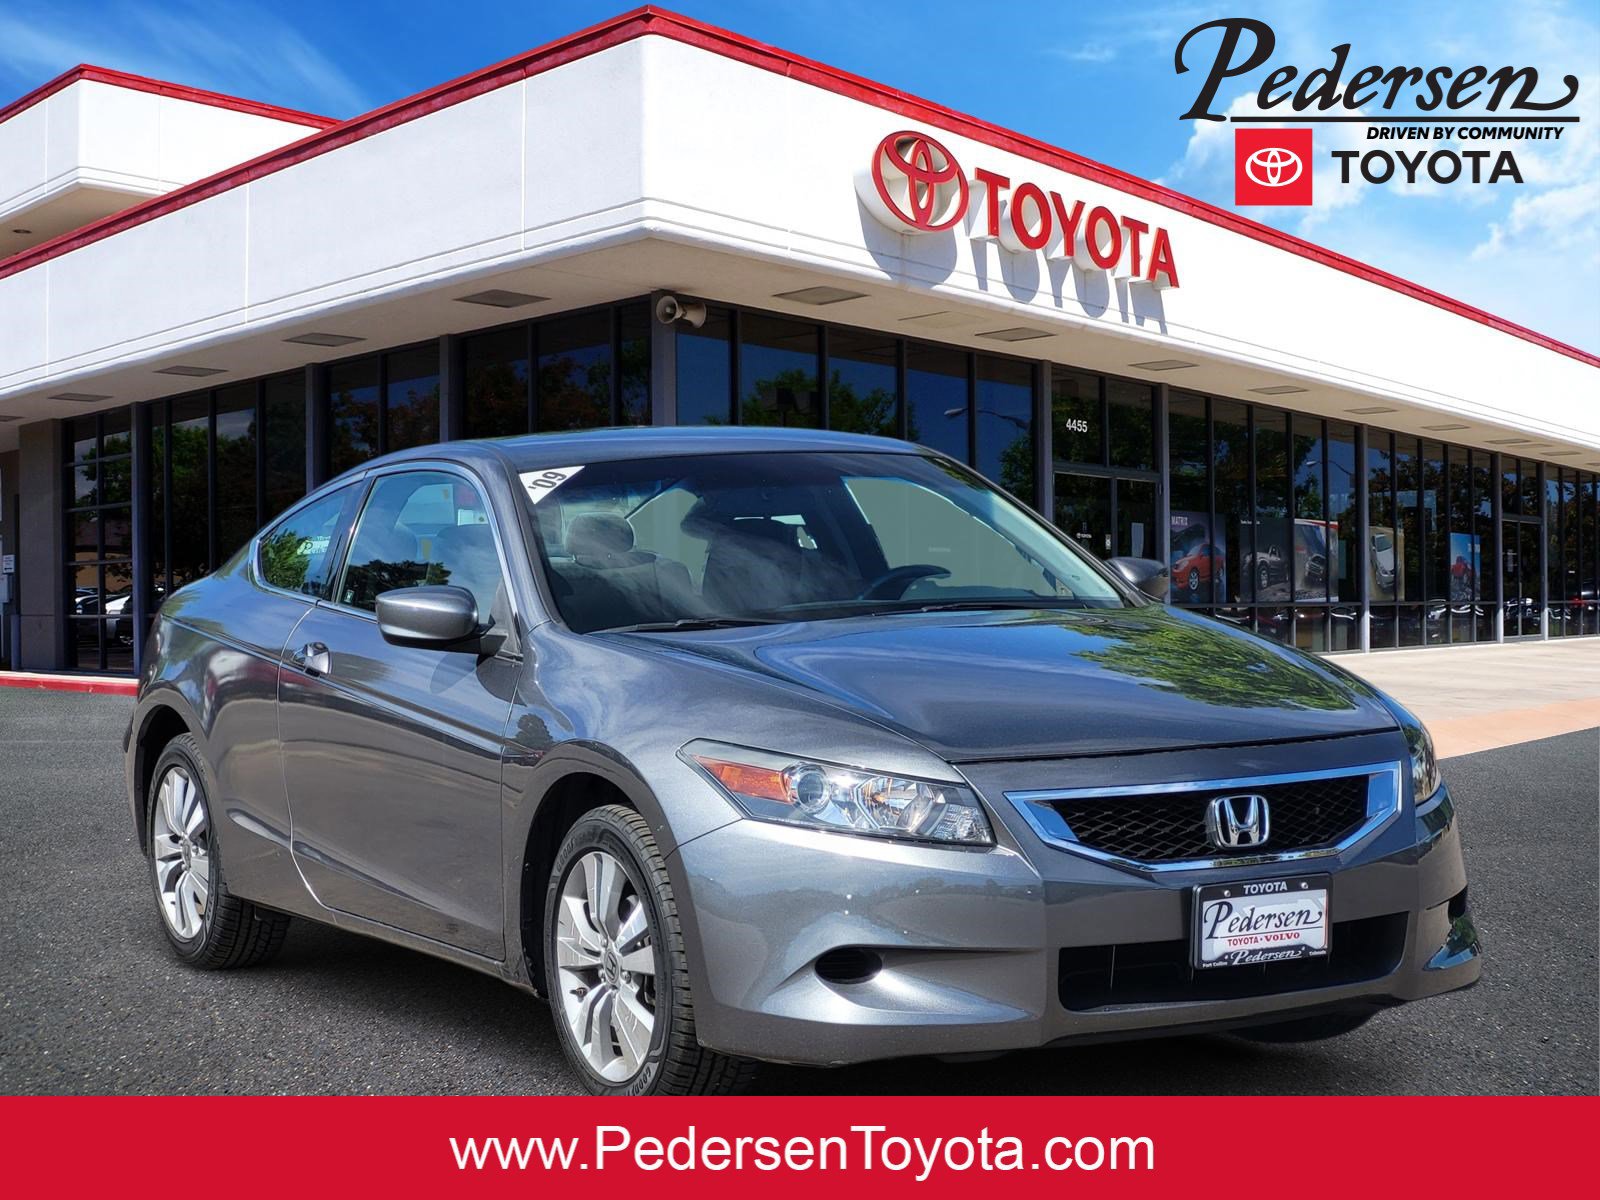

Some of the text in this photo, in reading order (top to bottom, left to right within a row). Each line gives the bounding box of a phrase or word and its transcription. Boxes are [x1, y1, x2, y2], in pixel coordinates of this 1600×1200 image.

[973, 166, 1180, 289] TOYOTA
[1065, 418, 1088, 433] 4455
[1243, 881, 1288, 895] TOYOTA
[1203, 900, 1323, 940] Pedersen
[1227, 932, 1300, 947] TOYOTA VOLVO
[1230, 949, 1302, 966] Pedersen
